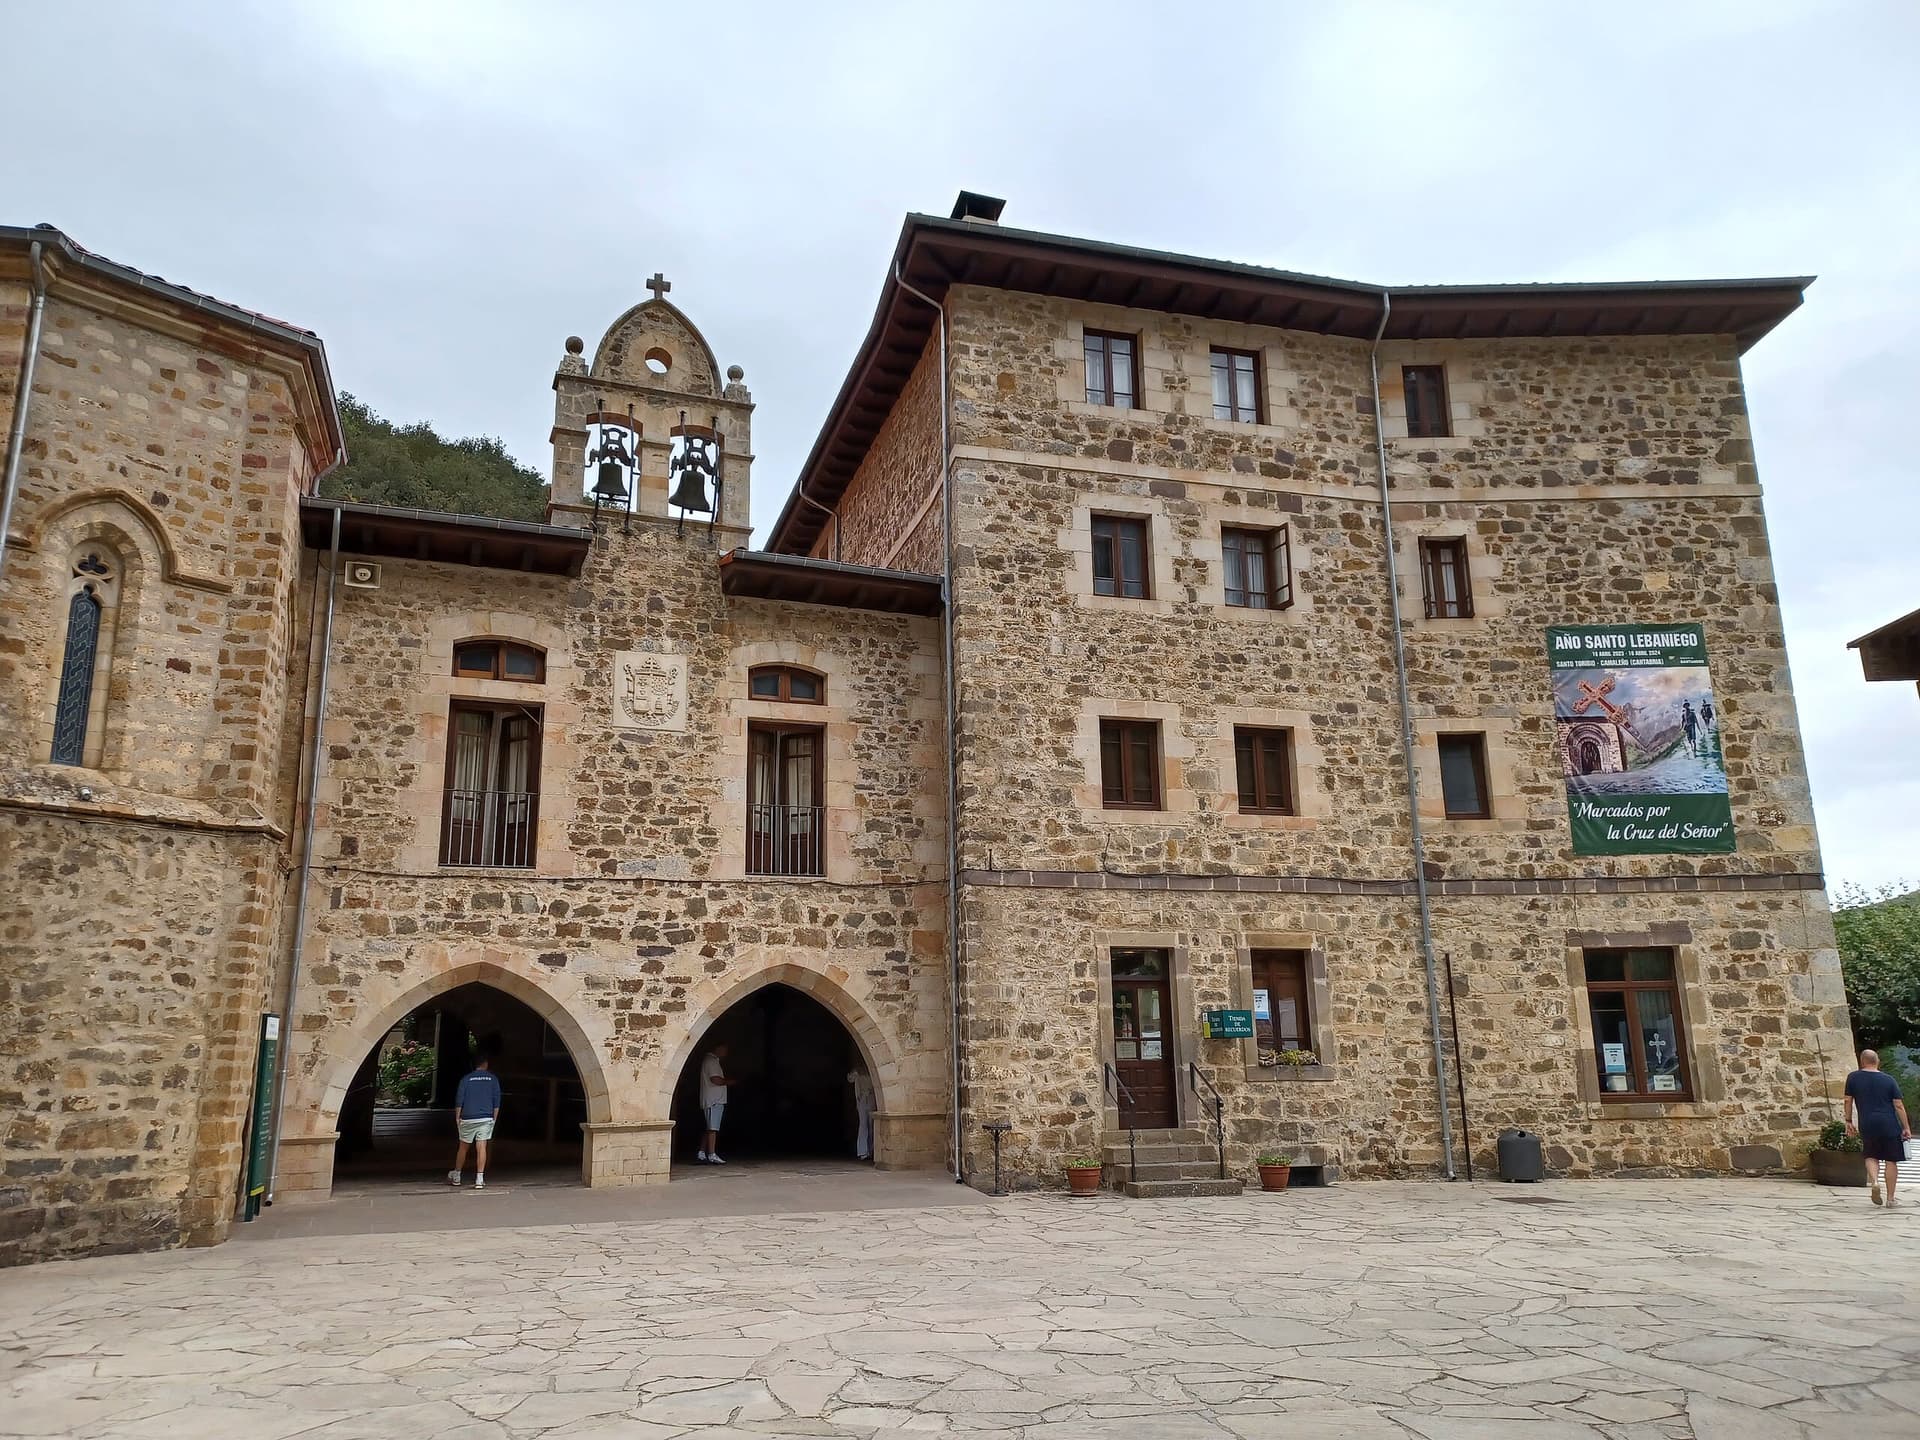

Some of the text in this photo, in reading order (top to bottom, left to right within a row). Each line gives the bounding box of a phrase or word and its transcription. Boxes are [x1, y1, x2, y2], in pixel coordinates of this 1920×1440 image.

[1555, 633, 1698, 650] AÑO SANTO LEBANIEGO
[1573, 802, 1670, 821] "Marcados por
[1607, 822, 1728, 840] la Cruz del Señor"
